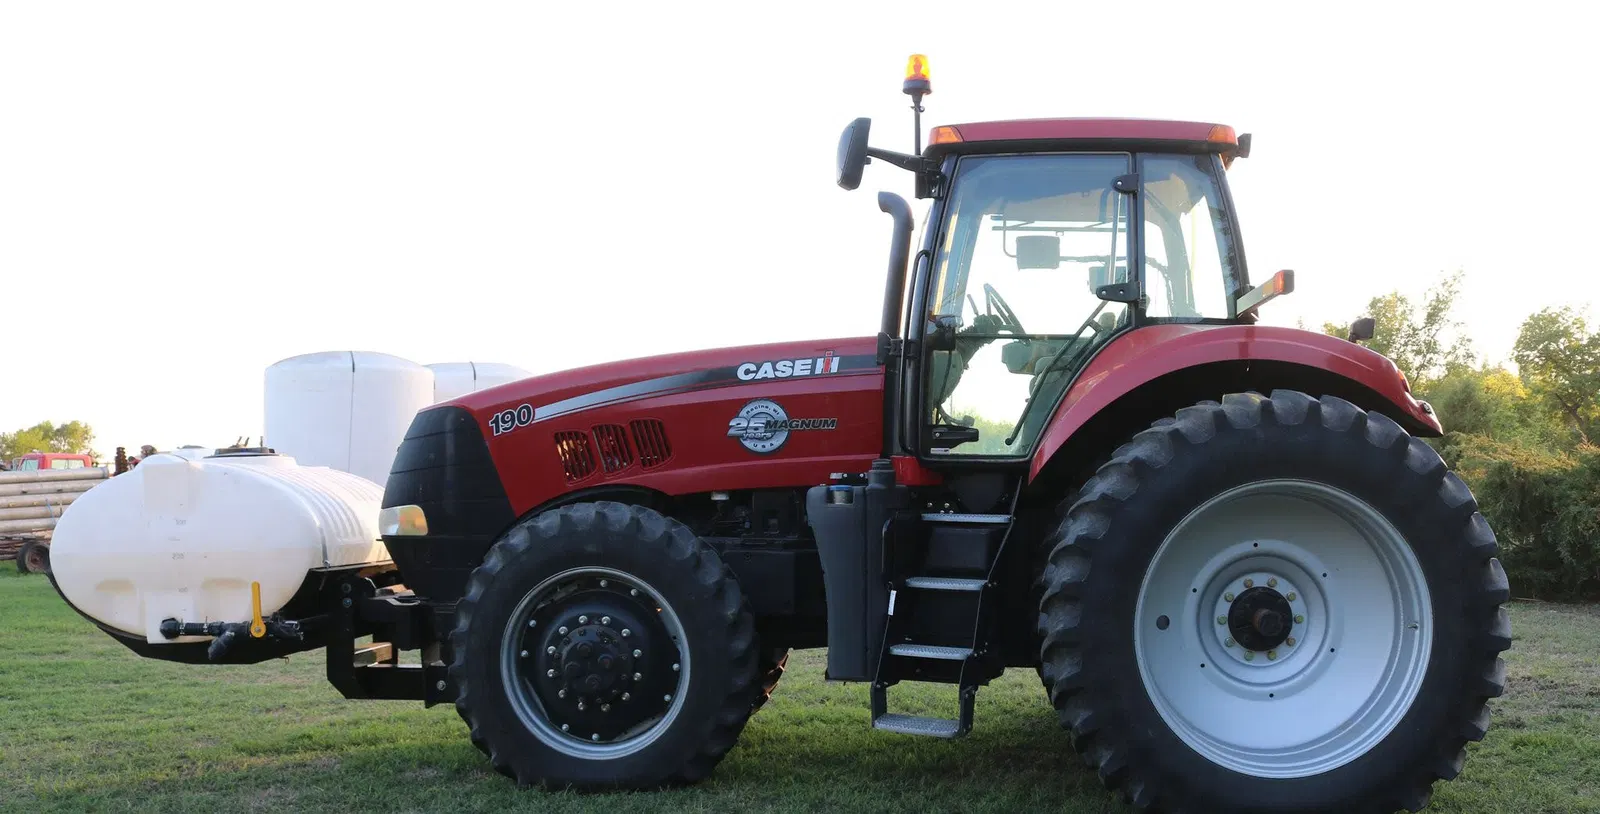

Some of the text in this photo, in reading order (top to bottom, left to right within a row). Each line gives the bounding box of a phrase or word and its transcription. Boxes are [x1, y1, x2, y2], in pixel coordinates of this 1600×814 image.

[737, 359, 812, 380] CASE
[489, 404, 533, 436] 190
[764, 418, 838, 431] MAGNUM
